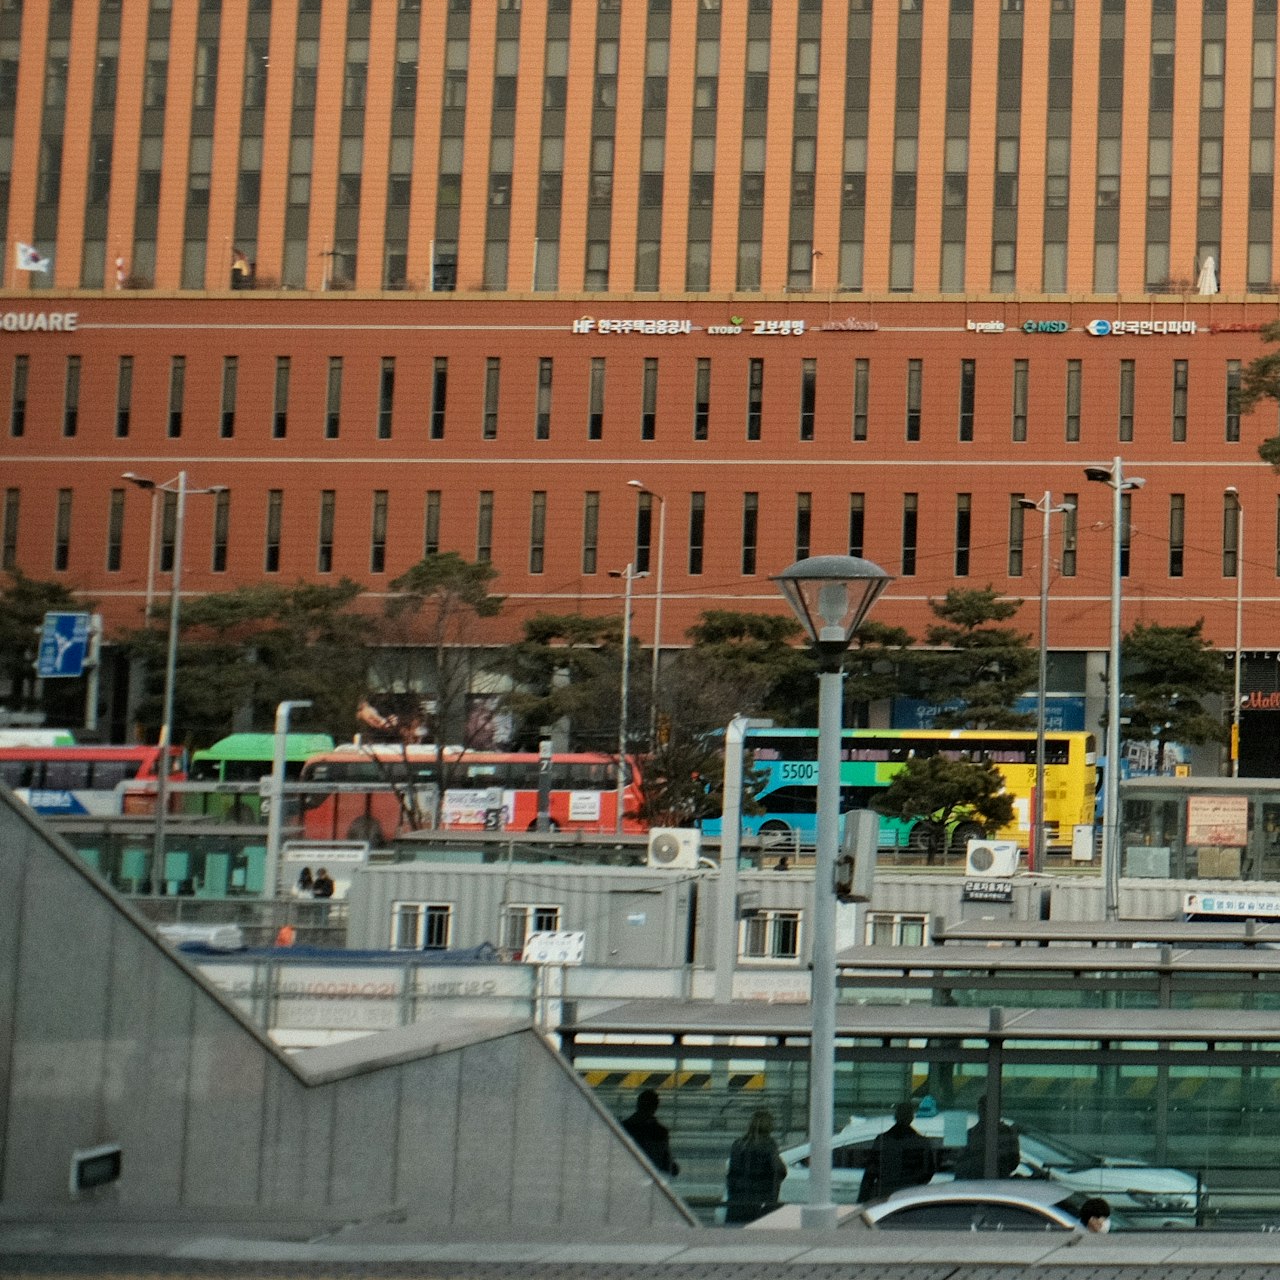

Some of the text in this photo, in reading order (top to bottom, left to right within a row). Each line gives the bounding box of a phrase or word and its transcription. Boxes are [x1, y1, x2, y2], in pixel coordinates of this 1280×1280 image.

[573, 319, 595, 334] HF
[708, 320, 805, 335] KYOBO 교보생명
[1038, 321, 1068, 333] MSD
[1112, 320, 1197, 335] 한국먼디파마
[783, 764, 819, 779] 5500-
[487, 813, 496, 827] 5
